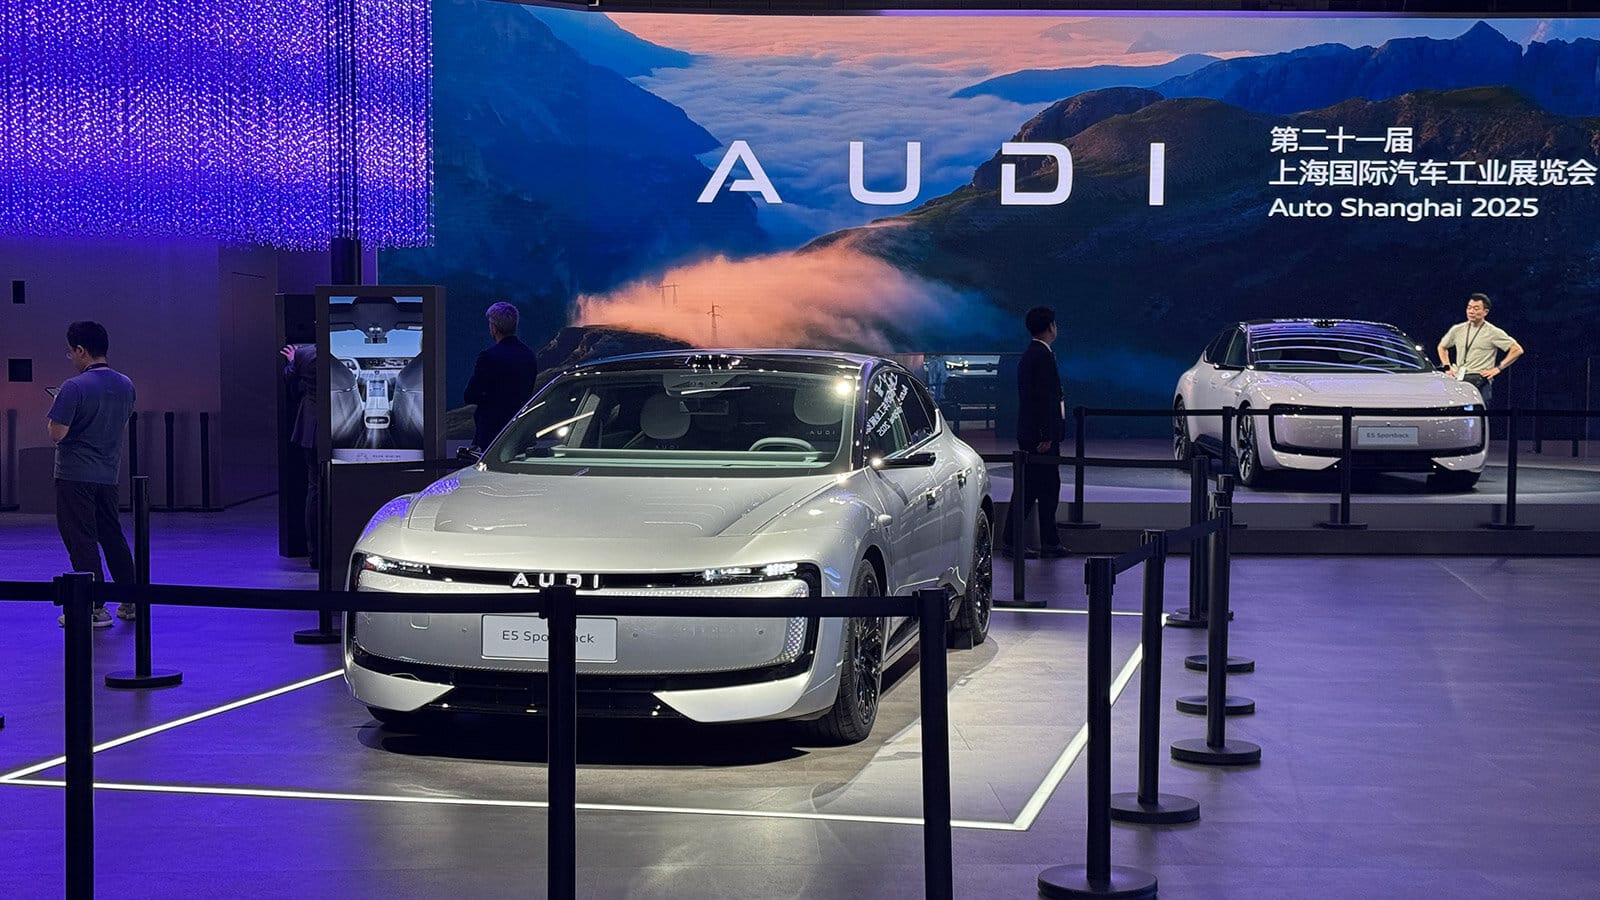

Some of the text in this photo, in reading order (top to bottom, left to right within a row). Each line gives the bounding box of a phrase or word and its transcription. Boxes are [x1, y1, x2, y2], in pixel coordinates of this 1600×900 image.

[1270, 126, 1413, 153] 第二十一届
[697, 140, 1165, 206] AUDI
[1268, 159, 1598, 186] 上海国际汽车工业展览会
[1268, 197, 1539, 222] Auto Shanghai 2025
[512, 572, 599, 588] AUDI
[502, 630, 594, 643] E5 Spock
